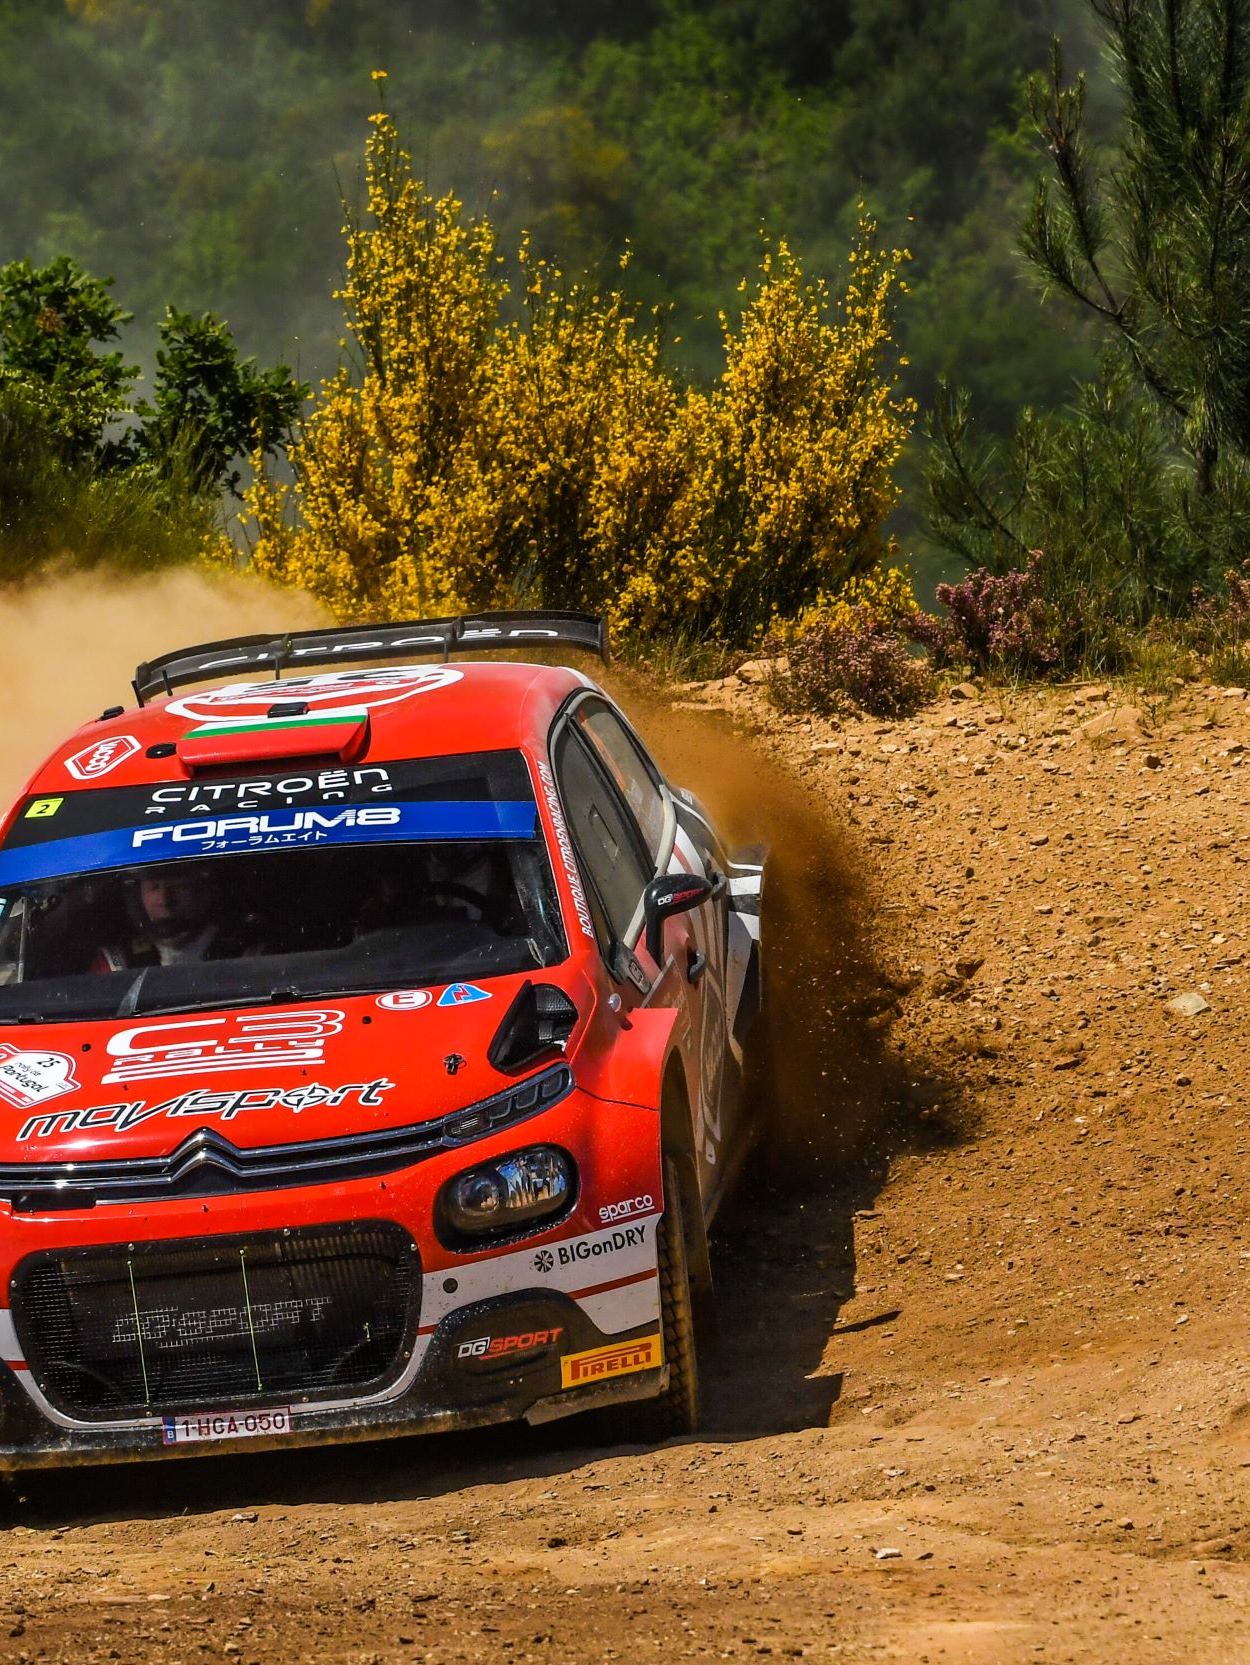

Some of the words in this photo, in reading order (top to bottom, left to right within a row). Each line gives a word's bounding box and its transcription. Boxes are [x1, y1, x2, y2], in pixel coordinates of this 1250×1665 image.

[35, 803, 51, 815] 2
[144, 783, 393, 815] RACING
[132, 806, 402, 848] FORUM8
[201, 830, 328, 850] フォーラムエイト
[392, 992, 415, 1005] E
[106, 1009, 346, 1056] C3
[35, 1057, 61, 1068] 25
[598, 1194, 654, 1222] sparco
[558, 1225, 646, 1266] BIGonDRY
[570, 1342, 653, 1381] PIRELLI
